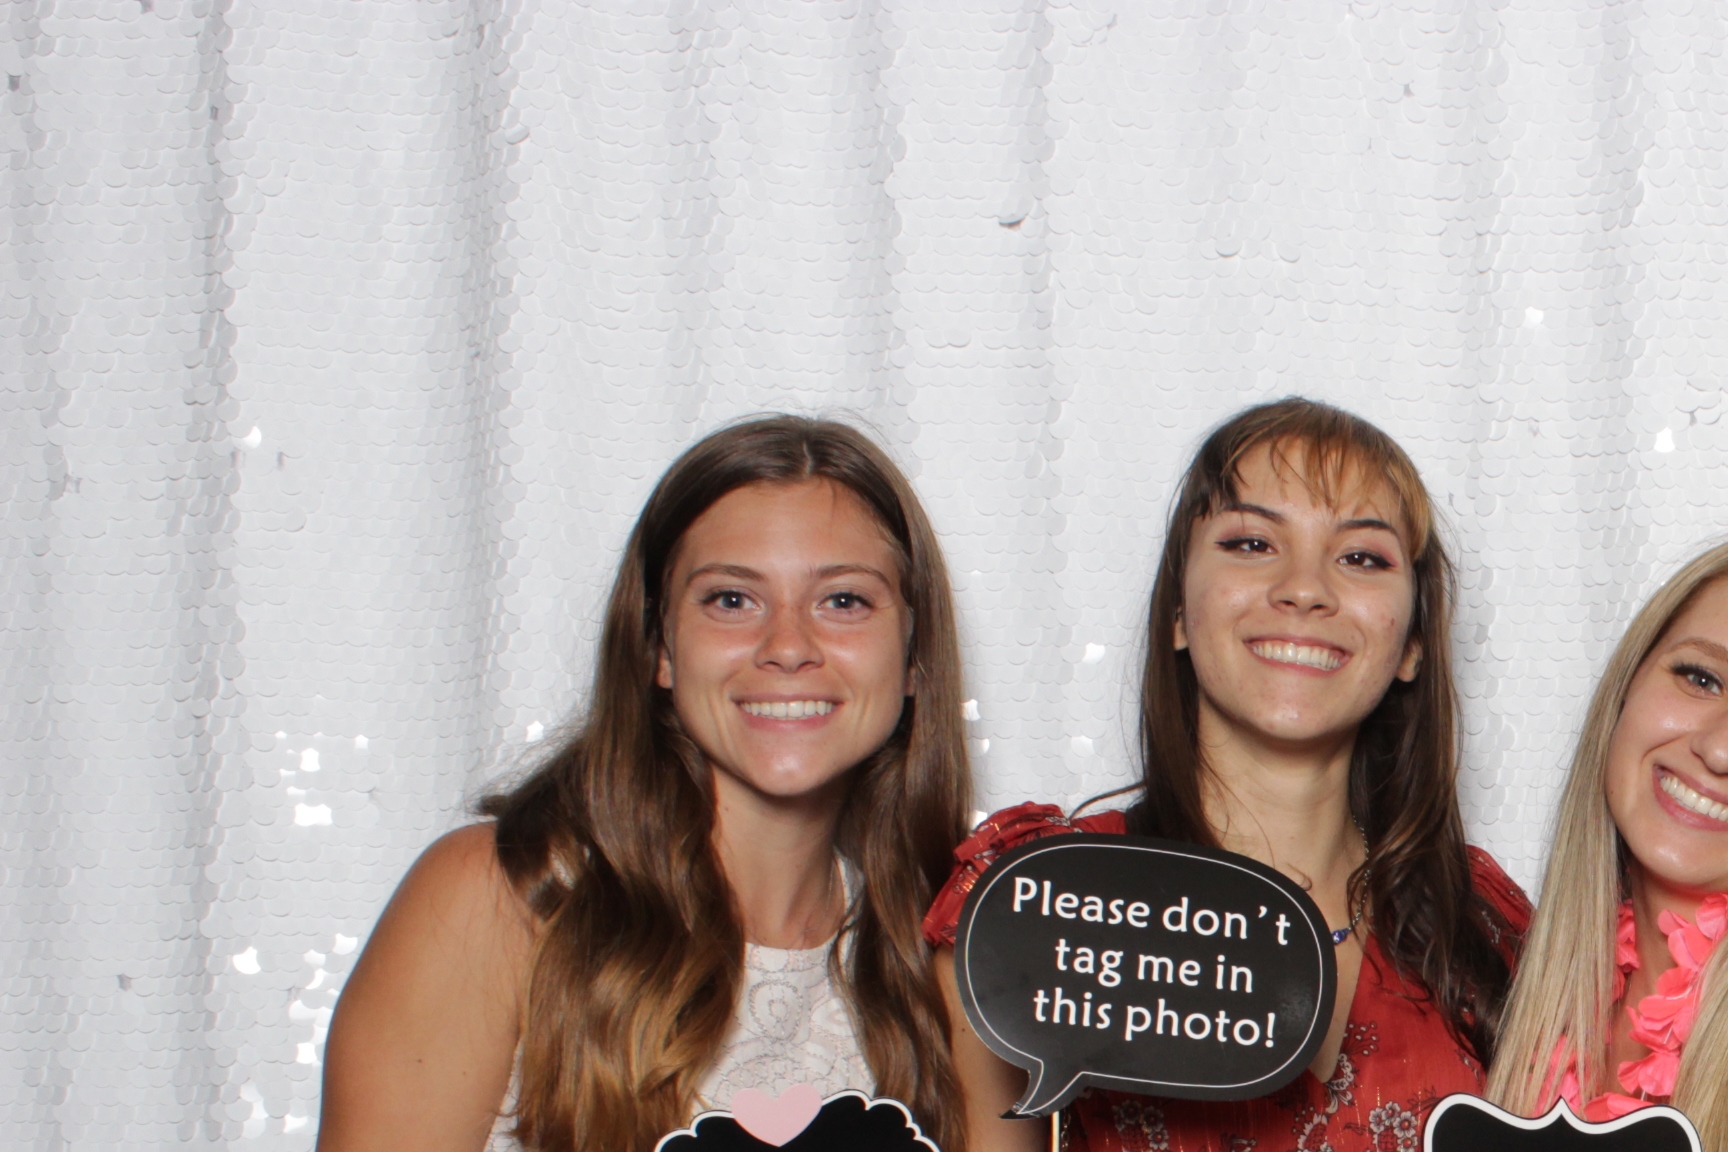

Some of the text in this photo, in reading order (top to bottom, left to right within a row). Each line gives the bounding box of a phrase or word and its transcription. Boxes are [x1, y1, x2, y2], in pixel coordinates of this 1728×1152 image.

[1012, 876, 1151, 929] Please
[1055, 938, 1254, 994] tag me in
[1033, 987, 1276, 1049] this photo!
